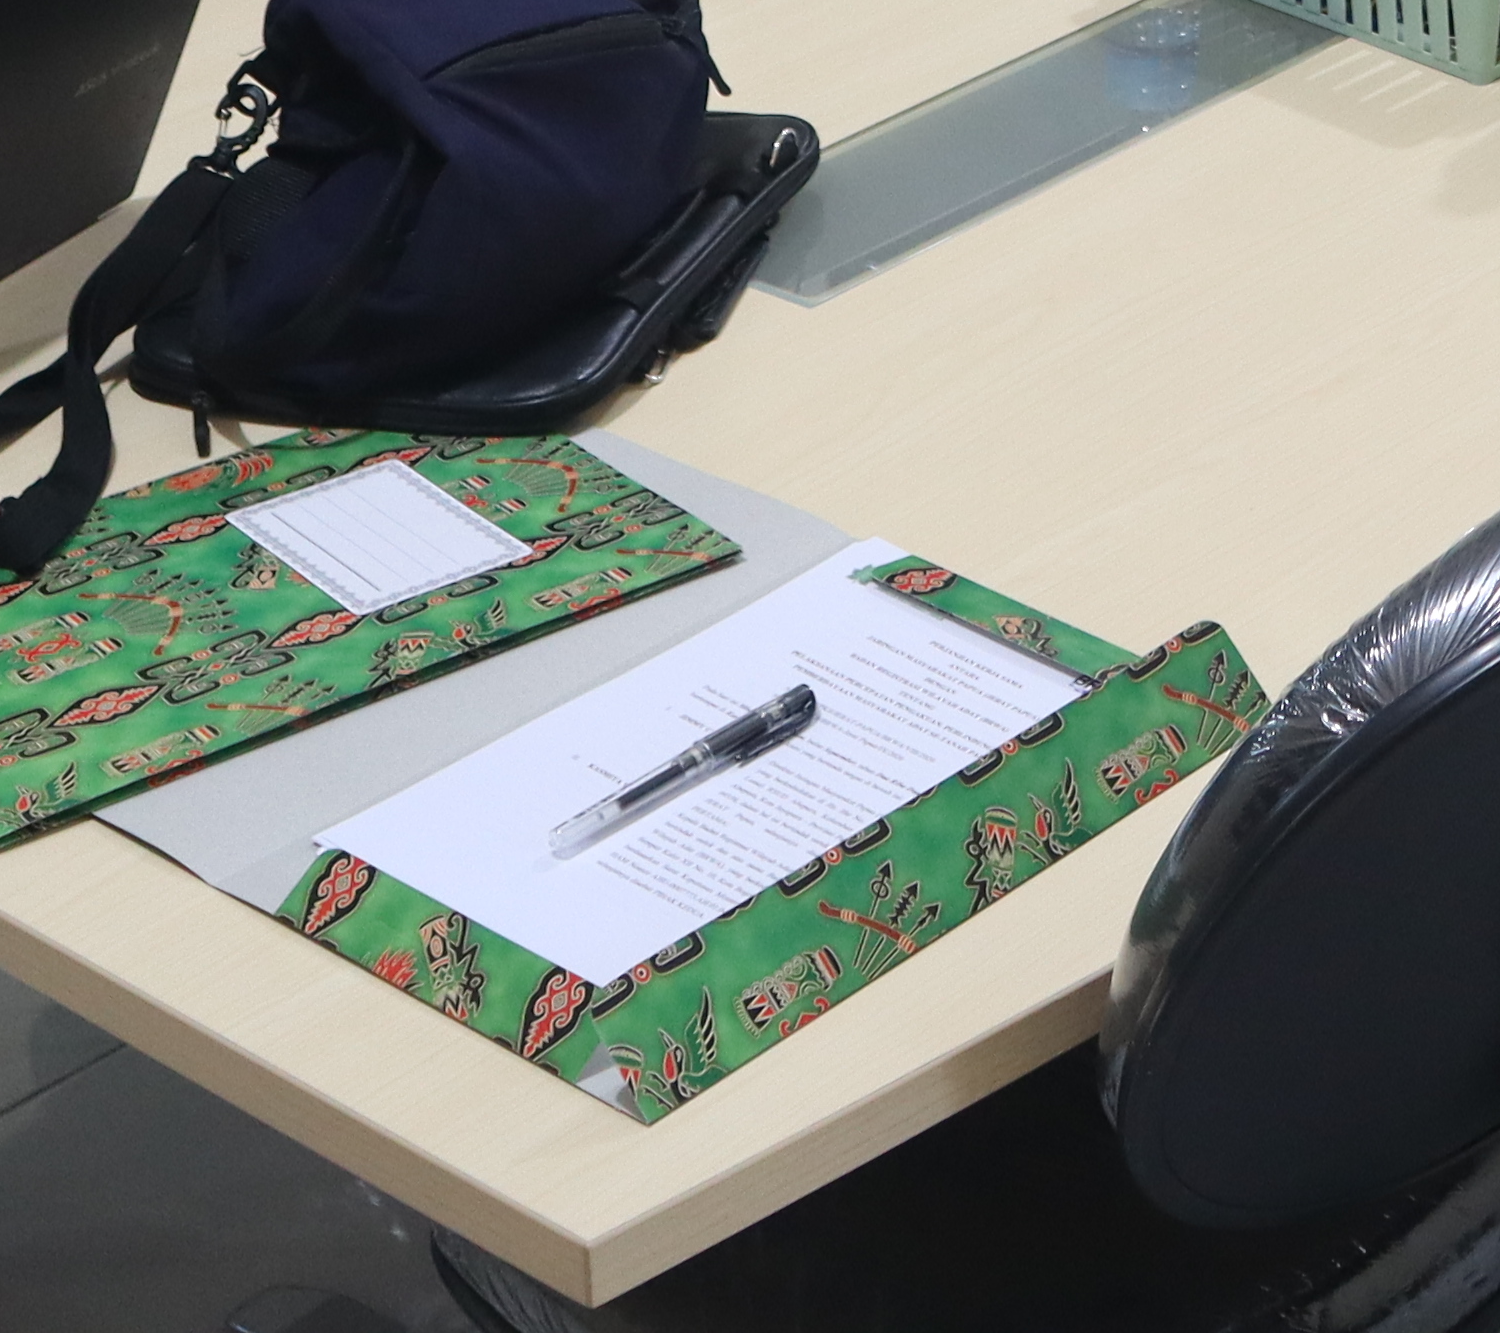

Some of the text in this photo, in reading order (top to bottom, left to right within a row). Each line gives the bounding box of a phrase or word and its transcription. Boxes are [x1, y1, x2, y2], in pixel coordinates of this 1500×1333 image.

[849, 653, 877, 667] BADAN
[866, 636, 906, 655] JARINGAN
[904, 654, 959, 682] MASYARAKAT
[957, 680, 985, 694] PAPUA
[928, 641, 1024, 688] PERJANJIAN KERJA SAMA
[948, 664, 981, 680] ANTARA
[790, 650, 847, 678] PELAKSANAAN
[844, 677, 897, 703] PERCEPATAN
[922, 677, 957, 694] DENGAN
[853, 695, 908, 722] MASYARAKAT
[906, 721, 930, 733] ADAT
[897, 691, 936, 710] TENTANG
